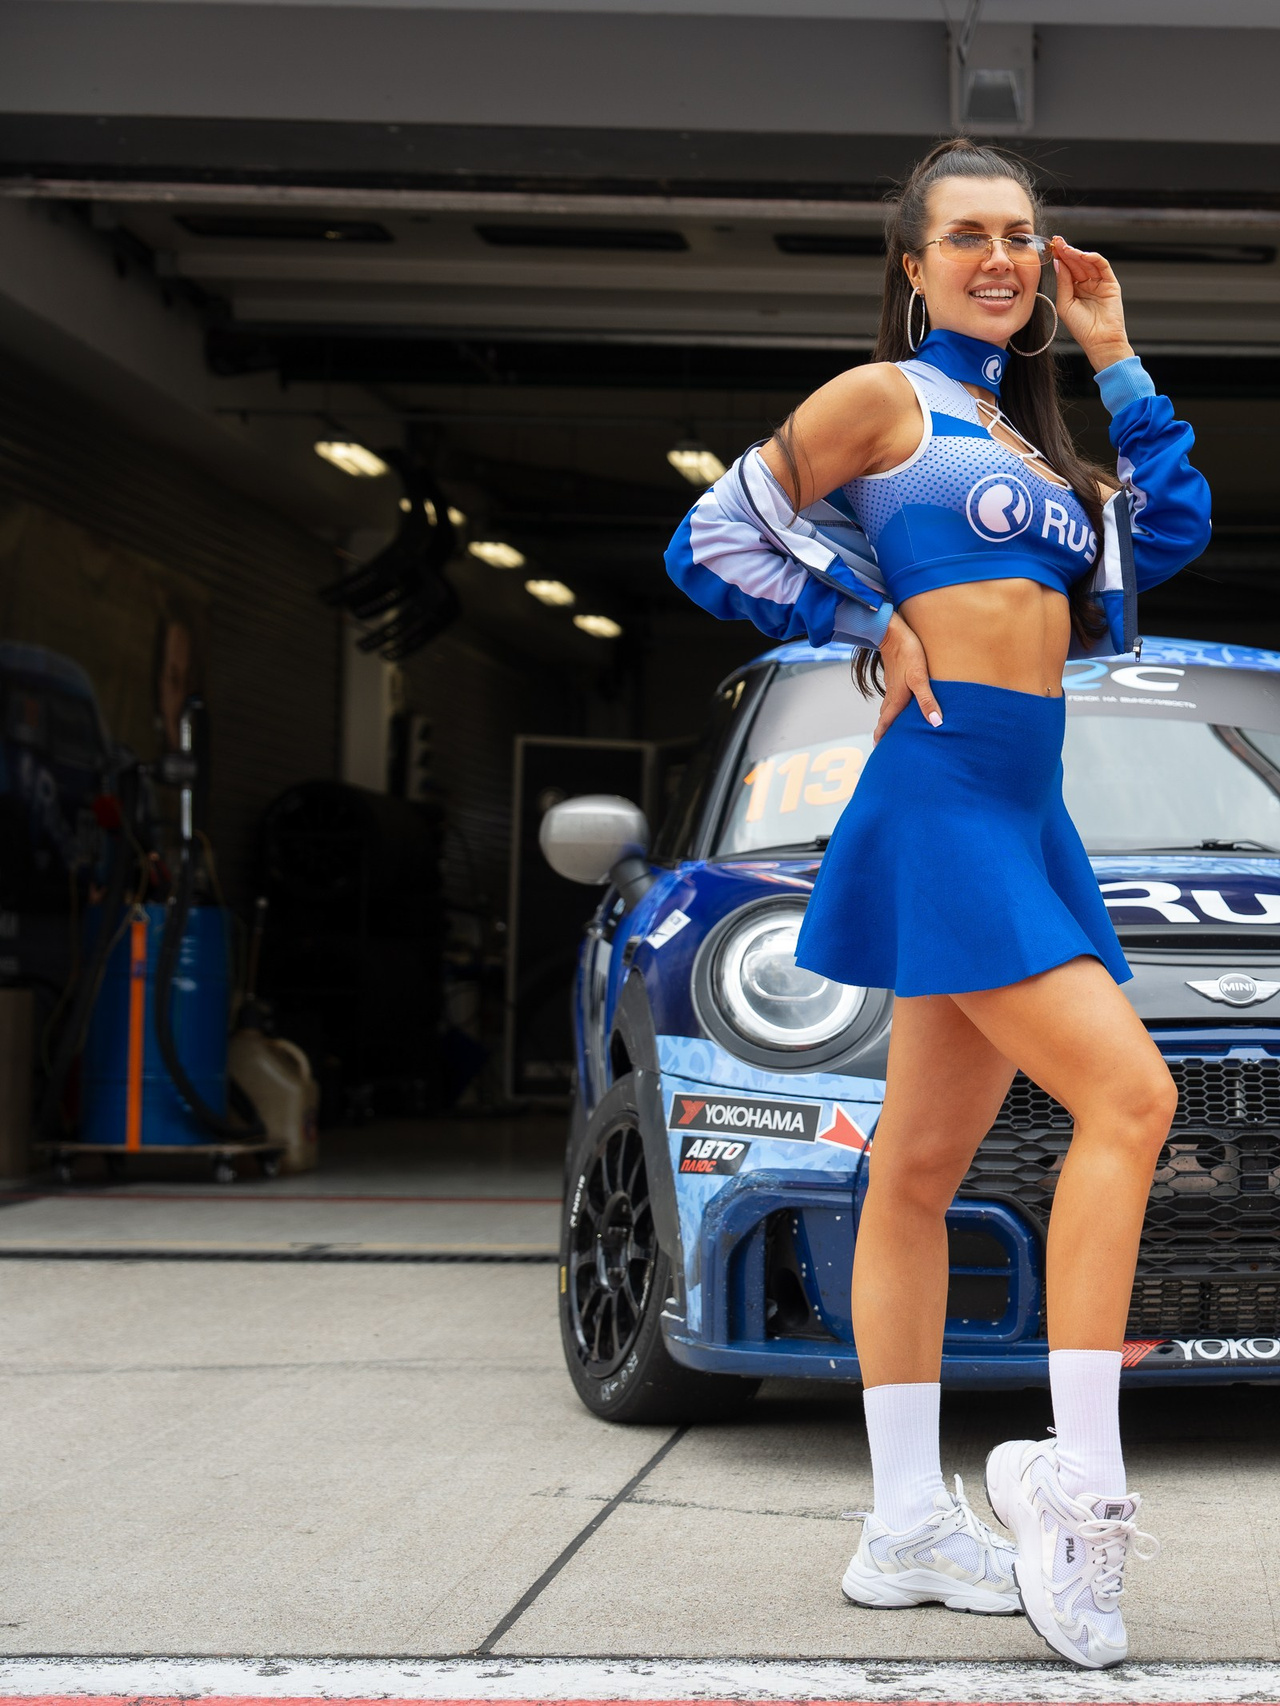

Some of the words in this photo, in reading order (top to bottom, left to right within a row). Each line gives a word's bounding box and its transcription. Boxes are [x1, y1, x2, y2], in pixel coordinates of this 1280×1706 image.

[743, 746, 864, 823] 113
[1222, 982, 1254, 992] MINI
[704, 1103, 805, 1133] YOKOHAMA
[1065, 1537, 1075, 1564] FILA
